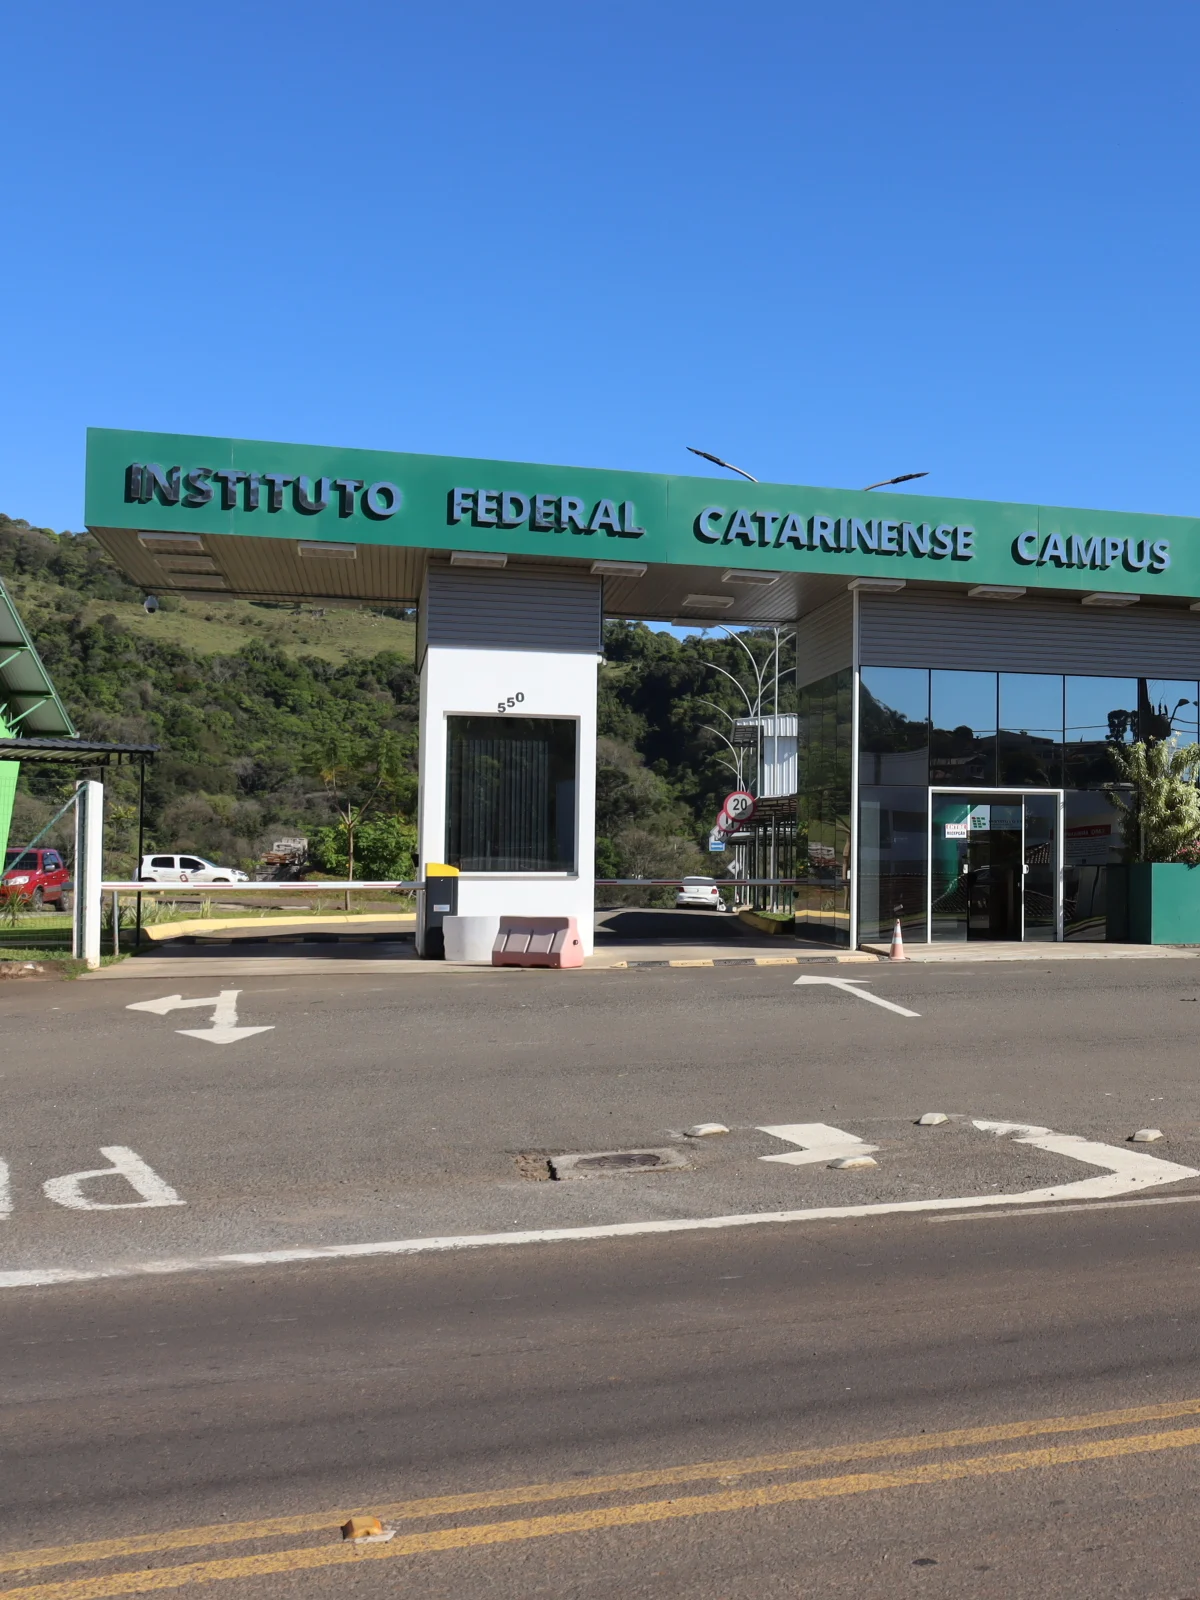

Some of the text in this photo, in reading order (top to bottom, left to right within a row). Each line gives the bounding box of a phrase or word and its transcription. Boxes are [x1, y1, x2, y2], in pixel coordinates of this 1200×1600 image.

[124, 462, 402, 520] INSTITUTO
[447, 487, 645, 539] FEDERAL
[693, 506, 975, 561] CATARINENSE
[1010, 530, 1171, 573] CAMPUS
[497, 692, 525, 713] 550
[733, 798, 748, 810] 20
